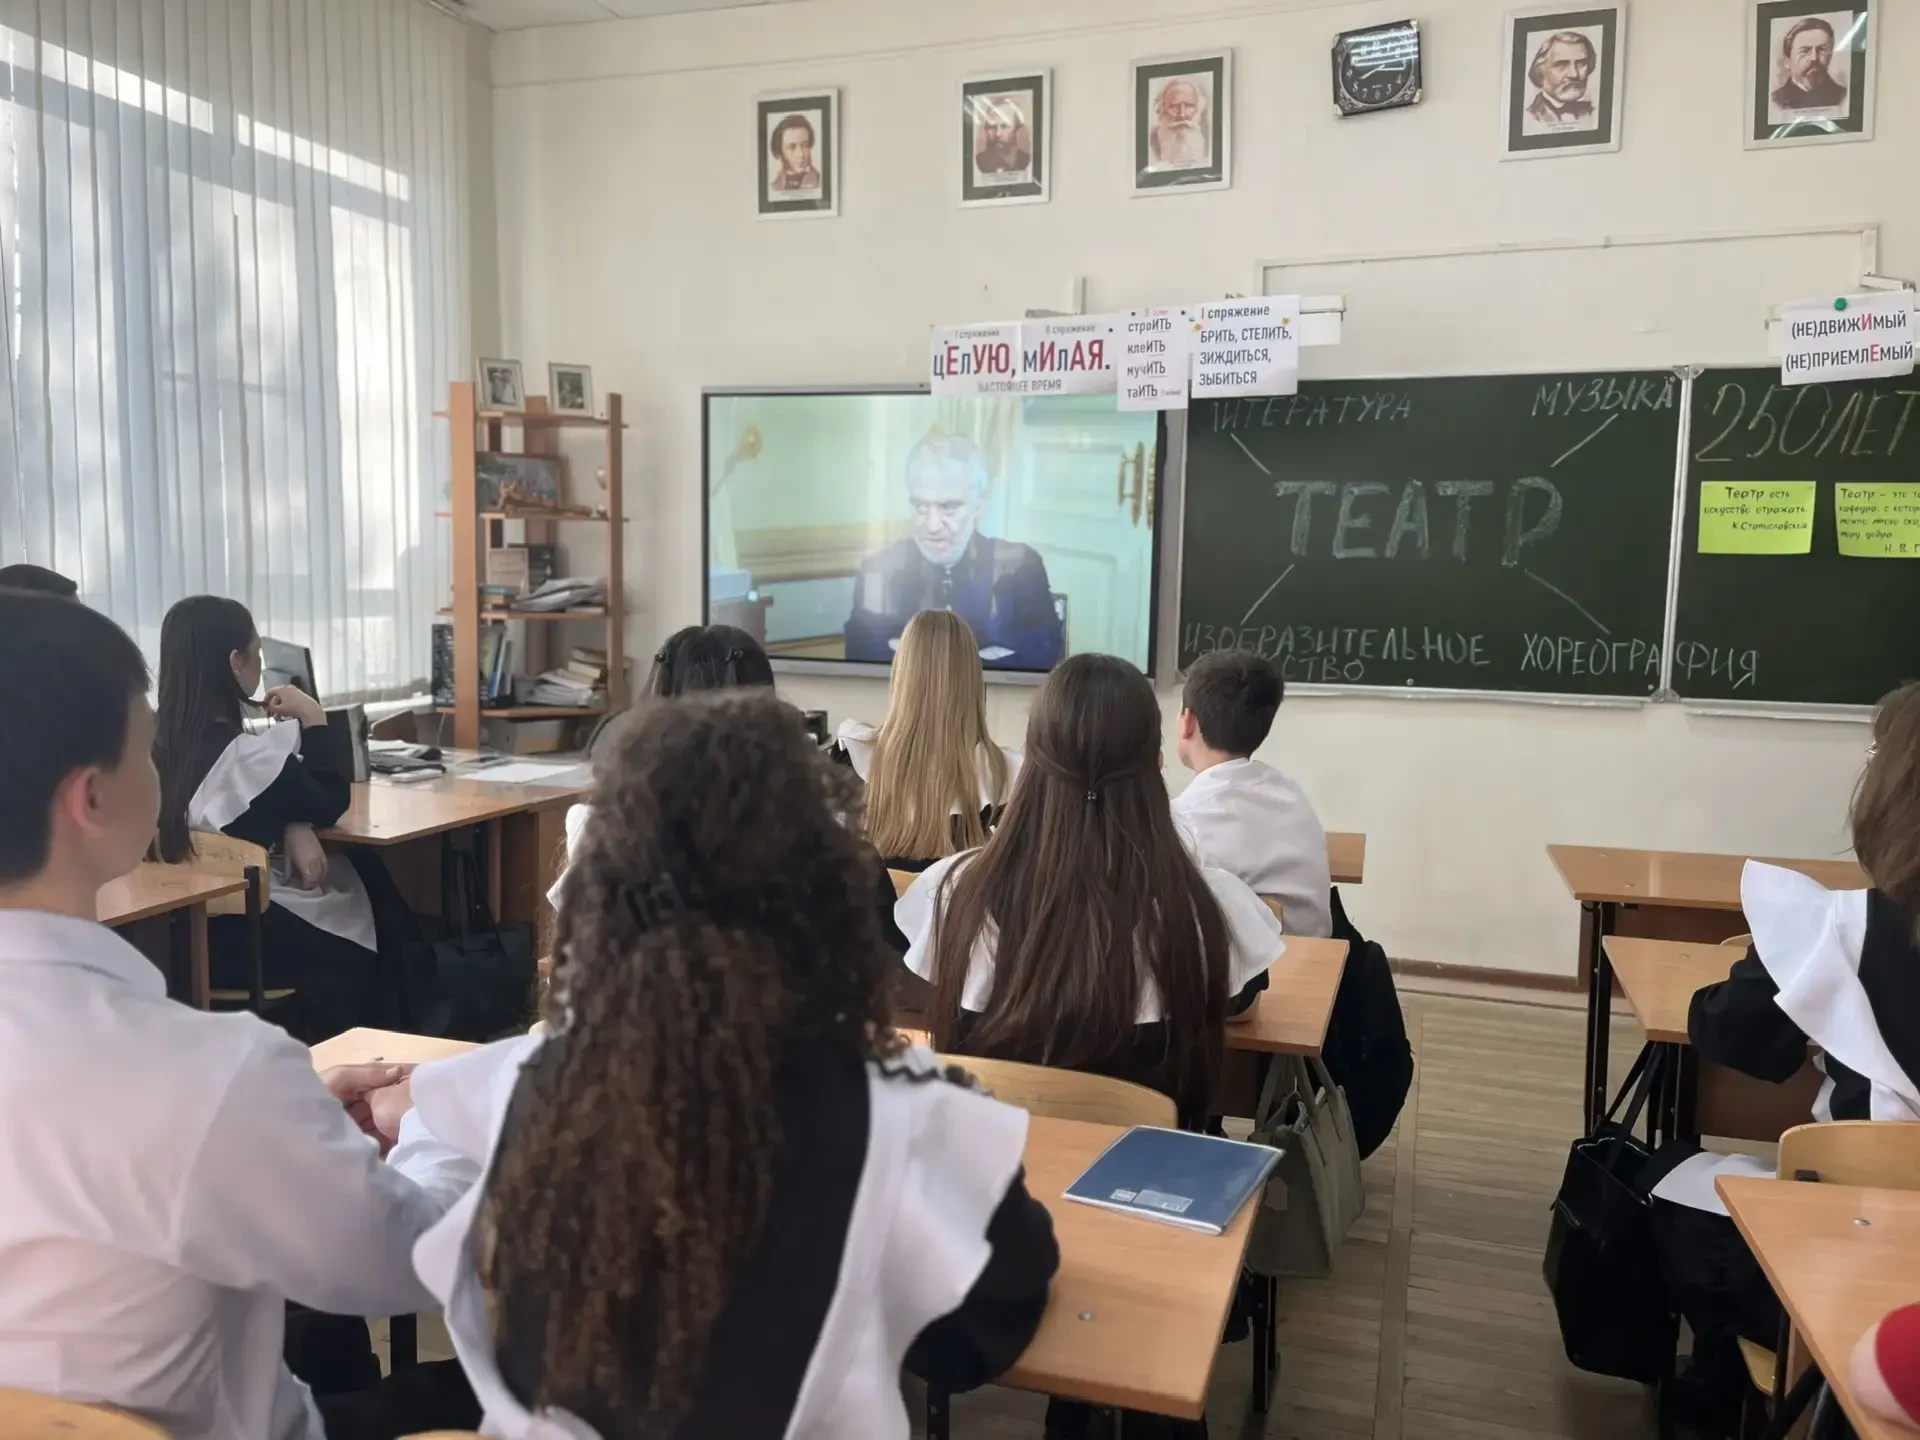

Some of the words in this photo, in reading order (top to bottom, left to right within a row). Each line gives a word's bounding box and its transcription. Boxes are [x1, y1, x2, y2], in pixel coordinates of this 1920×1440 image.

[1208, 306, 1270, 321] спряжение
[1128, 318, 1172, 334] строИТЬ
[1791, 309, 1907, 339] (НЕ)ДВИЖИМЫЙ
[1200, 329, 1238, 343] БРИТЬ,
[1242, 326, 1292, 341] СТЕЛИТЬ,
[1127, 340, 1166, 354] клеИТЬ
[1200, 348, 1271, 366] ЗИЖДИТЬСЯ,
[1785, 340, 1914, 372] (НЕ)ПРИЕМЛЕМЫЙ
[1127, 361, 1166, 378] мучИТЬ
[1199, 370, 1257, 386] ЗЫБИТЬСЯ
[1031, 379, 1062, 391] ВРЕМЯ
[1127, 384, 1158, 398] таИТЬ
[1531, 377, 1674, 417] МУЗЫКА
[1724, 486, 1765, 502] Театр
[1769, 490, 1790, 499] есть
[1840, 488, 1875, 500] Театр
[1274, 475, 1564, 567] ТЕАТР
[1184, 622, 1491, 667] ИЗОБРАЗИТЕЛЬНОЕ
[1520, 632, 1760, 690] ХОРЕОГРАФИЯ
